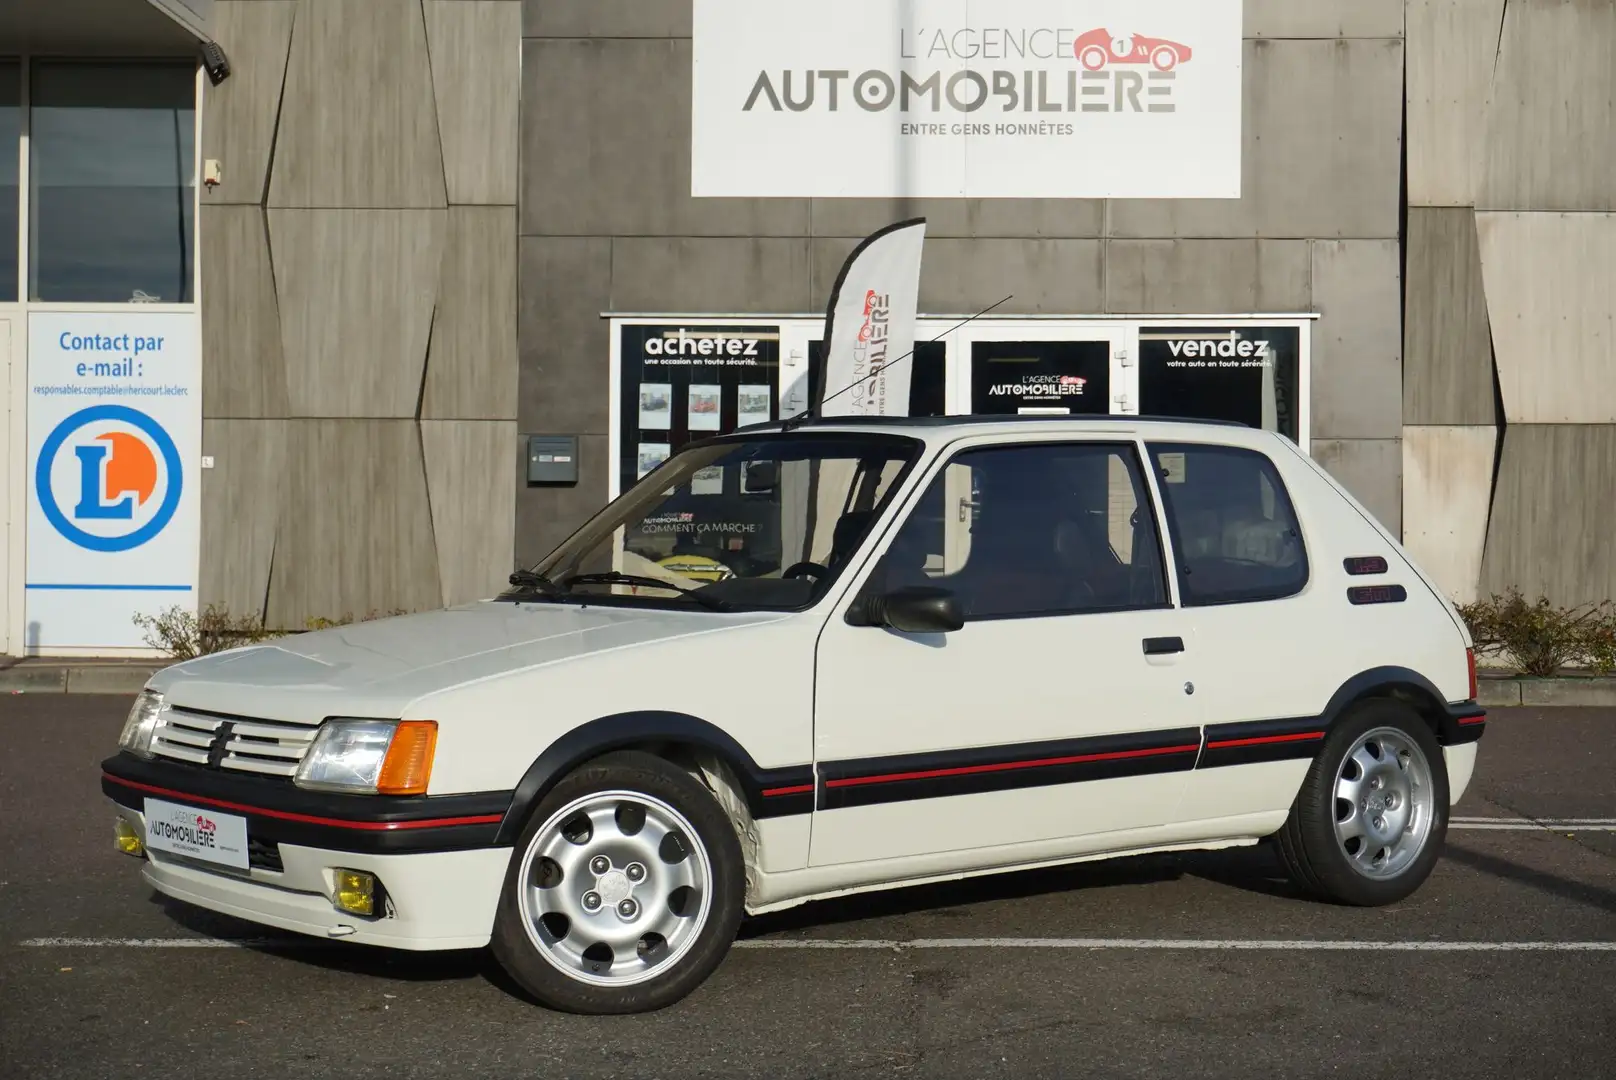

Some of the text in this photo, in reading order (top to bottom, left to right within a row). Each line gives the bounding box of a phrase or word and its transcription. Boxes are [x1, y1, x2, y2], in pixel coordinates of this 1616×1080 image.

[900, 28, 1074, 59] L'AGENCE
[901, 120, 1074, 136] ENTRE GENS HONNÊTES
[59, 332, 165, 355] Contact par
[645, 328, 758, 355] achetez
[1167, 330, 1269, 357] vendez
[76, 358, 134, 377] e-mail
[660, 358, 691, 366] occasion
[704, 358, 725, 366] toute
[1022, 375, 1061, 384] L'AGENCE
[75, 446, 133, 519] L
[641, 523, 696, 534] COMMENT
[711, 522, 756, 533] MARCHE
